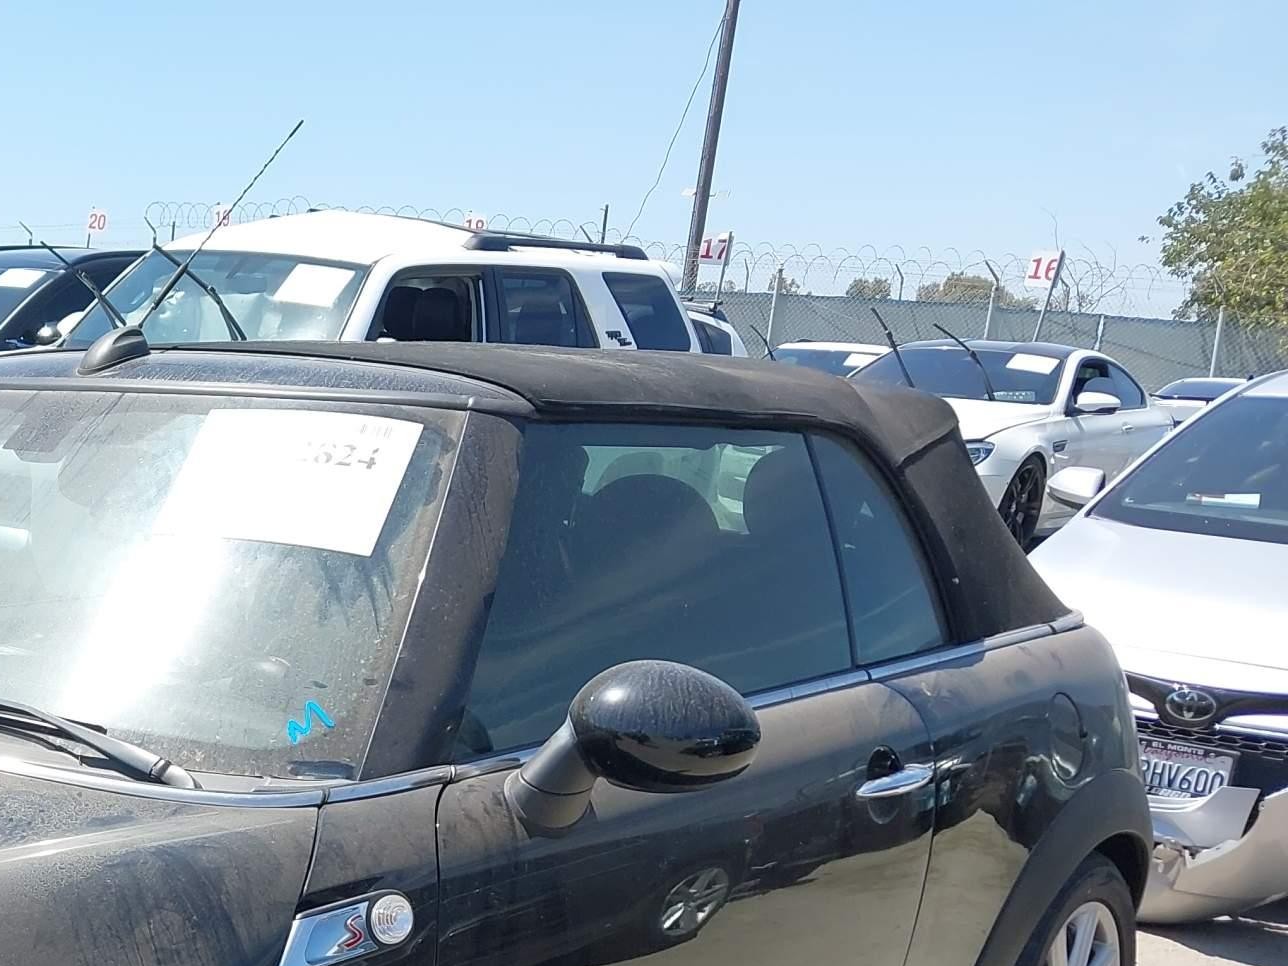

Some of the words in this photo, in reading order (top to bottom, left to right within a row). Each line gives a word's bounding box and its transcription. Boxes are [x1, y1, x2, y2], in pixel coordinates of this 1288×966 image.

[88, 213, 106, 230] 20
[700, 239, 727, 260] 17
[1028, 257, 1058, 281] 16
[342, 913, 365, 950] S
